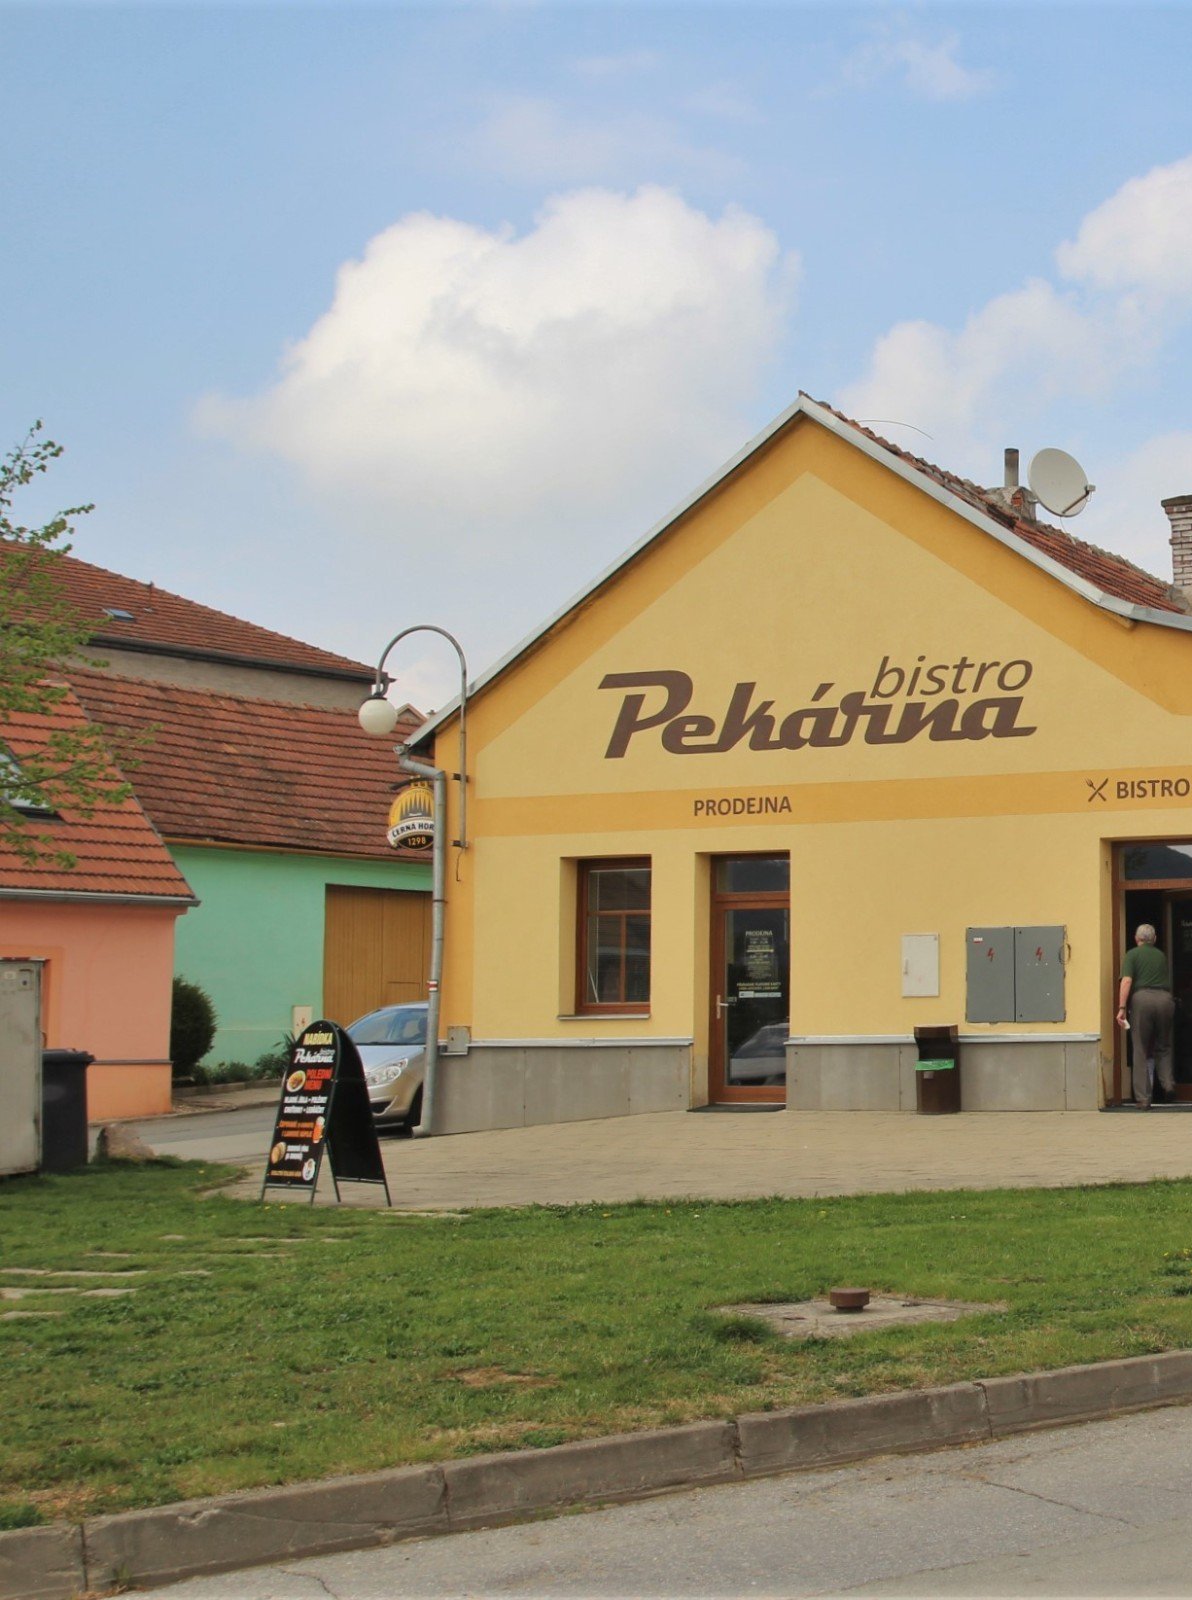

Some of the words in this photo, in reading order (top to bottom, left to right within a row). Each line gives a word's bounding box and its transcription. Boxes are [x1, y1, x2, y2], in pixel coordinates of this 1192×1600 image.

[870, 655, 1033, 699] bistro
[597, 669, 1038, 760] Pekárna
[1115, 777, 1192, 801] BISTRO
[693, 796, 793, 818] PRODEJNA
[418, 822, 434, 831] HOR
[408, 836, 426, 846] 1298
